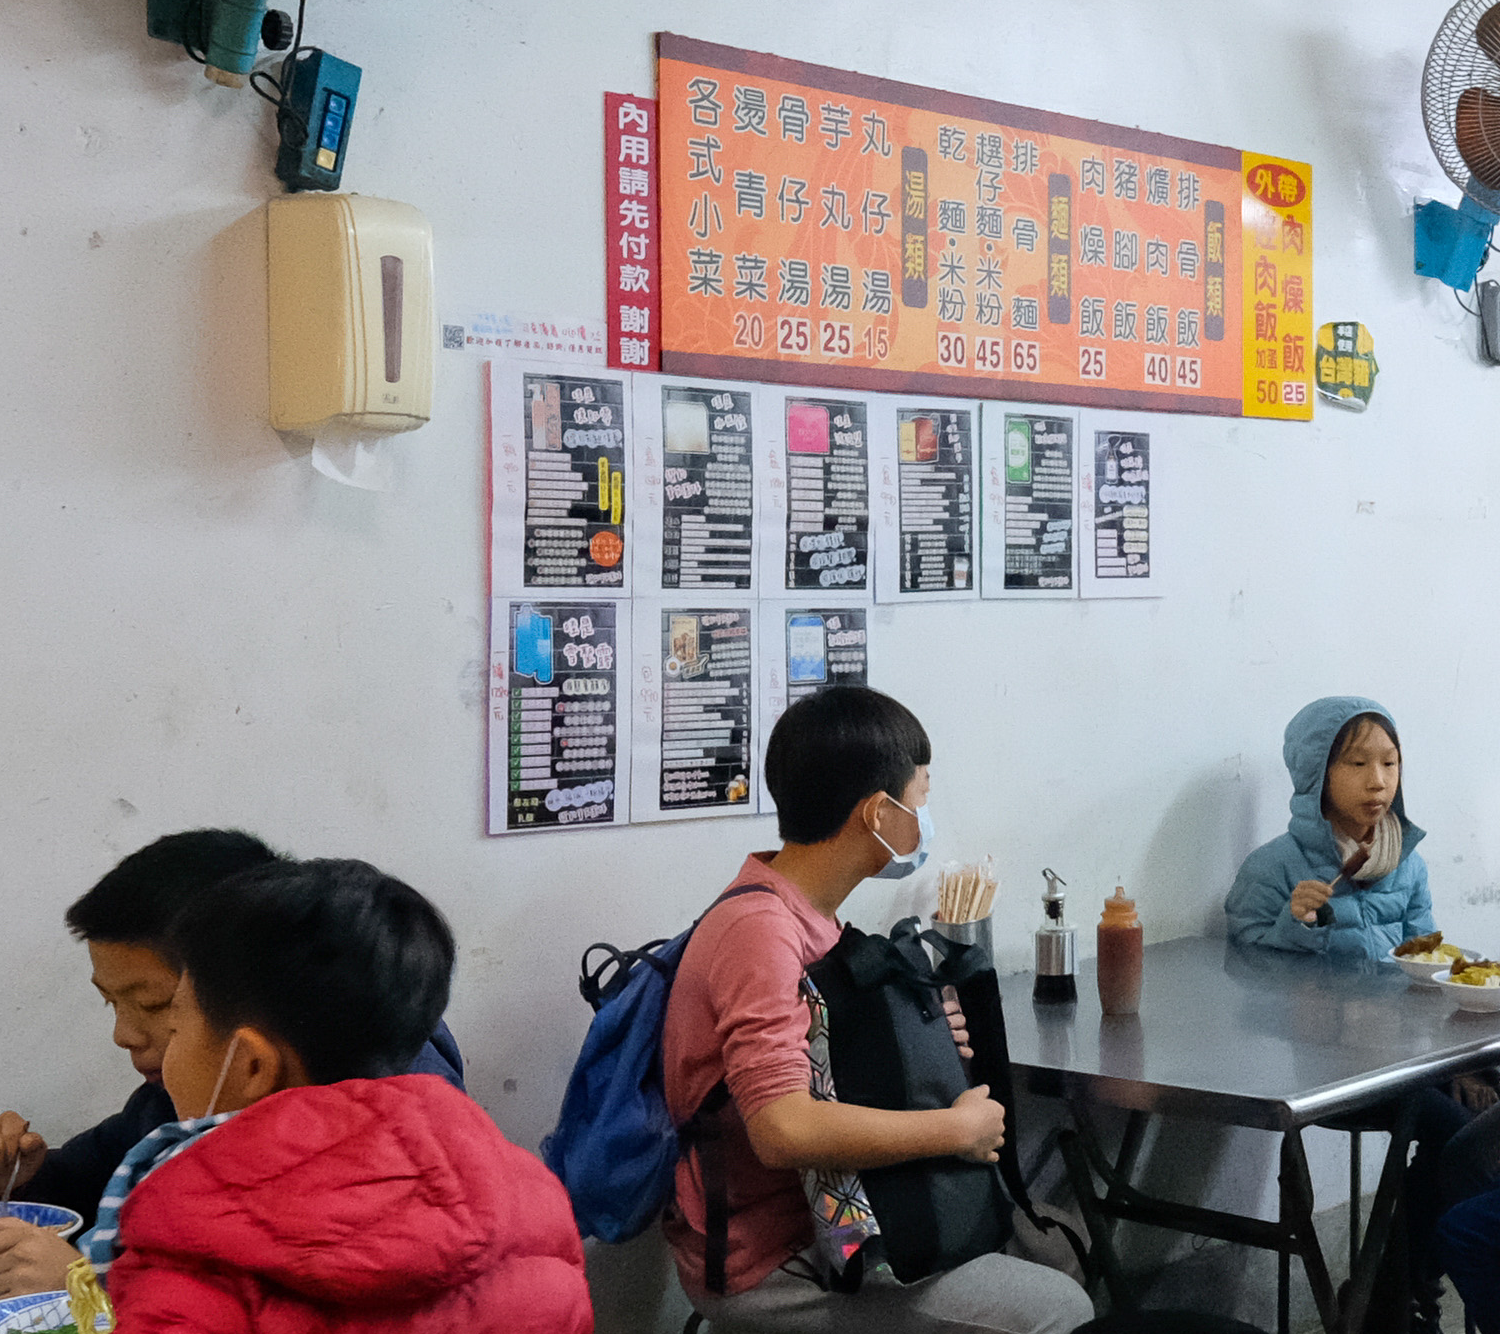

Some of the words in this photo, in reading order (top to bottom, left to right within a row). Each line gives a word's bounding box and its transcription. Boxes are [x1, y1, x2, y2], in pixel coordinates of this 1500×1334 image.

[618, 101, 650, 294] 內用請先付款
[687, 77, 723, 296] 各式小菜
[733, 85, 767, 302] 燙青菜
[778, 95, 810, 307] 骨仔湯
[820, 103, 851, 311] 芋丸湯
[861, 111, 892, 315] 丸仔湯
[1255, 169, 1299, 203] 外帶
[905, 170, 926, 281] 湯類
[1012, 139, 1039, 331] 排骨麵
[1051, 196, 1069, 299] 麵類
[1080, 155, 1105, 339] 肉燥飯
[1113, 158, 1138, 341] 豬腳飯
[1177, 171, 1200, 348] 排骨飯
[1207, 221, 1223, 317] 飯類
[619, 304, 650, 365] 謝謝
[734, 314, 763, 349] 20
[779, 320, 809, 353] 25
[822, 322, 852, 355] 25
[863, 326, 888, 359] 15
[940, 334, 965, 365] 30
[976, 339, 1001, 370] 45
[1013, 342, 1038, 372] 65
[1081, 348, 1104, 378] 25
[1146, 356, 1169, 384] 40
[1177, 359, 1199, 386] 45
[1256, 380, 1279, 405] 50
[1283, 383, 1306, 403] 25
